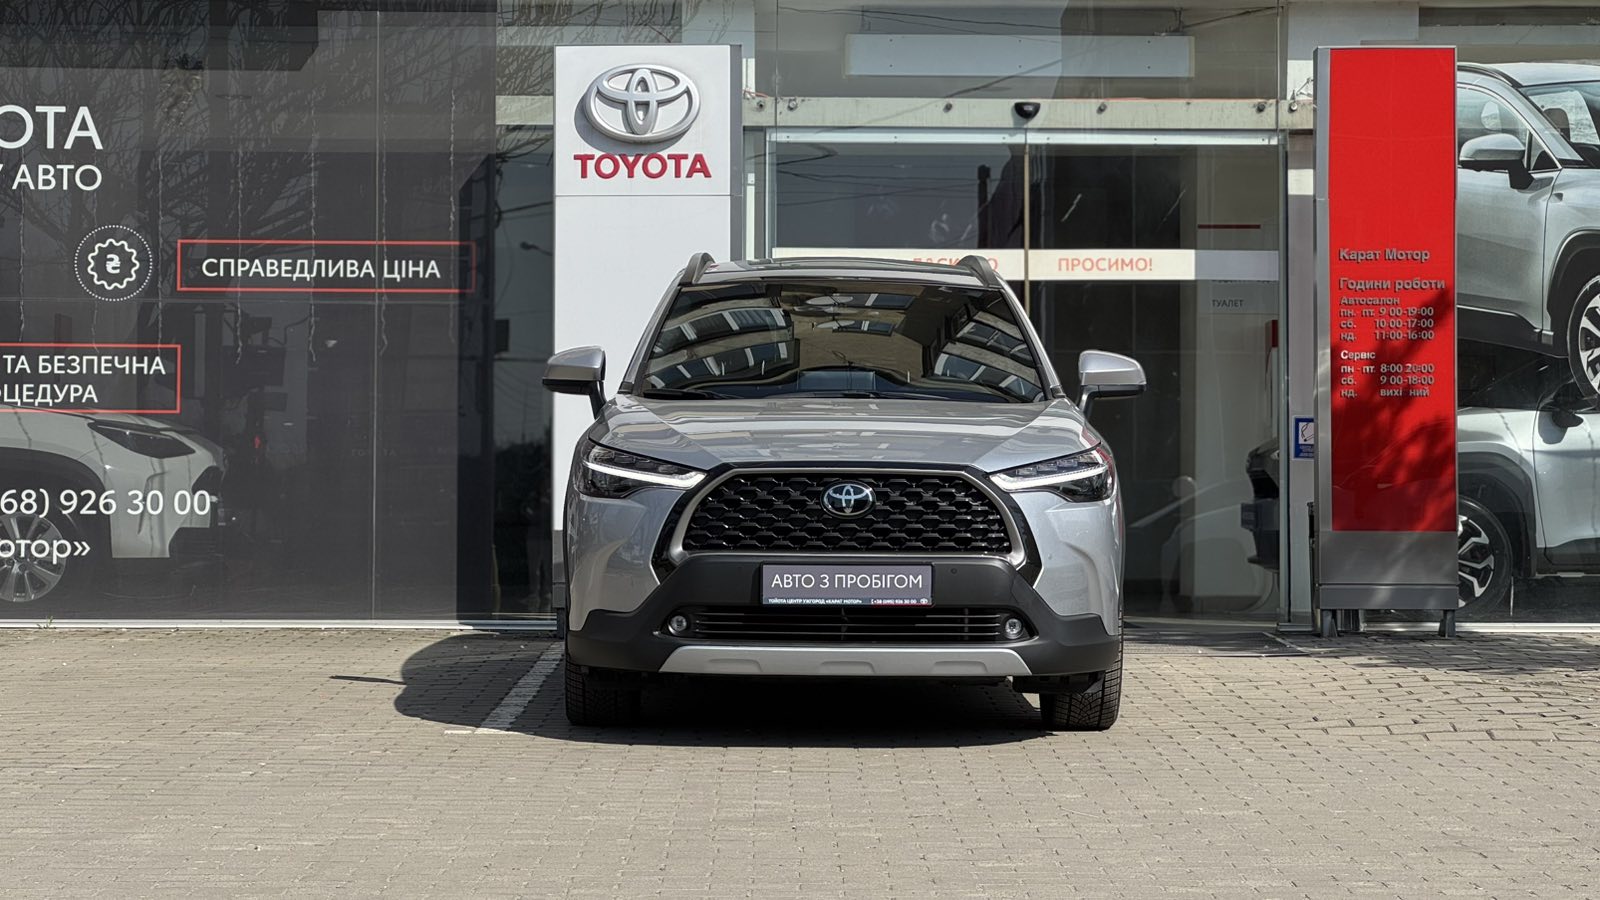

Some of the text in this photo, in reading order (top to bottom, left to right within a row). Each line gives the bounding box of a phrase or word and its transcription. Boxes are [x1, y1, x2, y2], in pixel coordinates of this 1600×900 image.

[573, 153, 712, 179] TOYOTA
[12, 163, 103, 191] АВТО
[1339, 248, 1431, 263] Карат Мотор
[202, 258, 441, 282] СПРАВЕДЛИВА ЦІНА
[1058, 257, 1153, 272] ПРОСИМО!
[1339, 276, 1446, 292] Години роботи
[1211, 299, 1245, 308] ТУАЛЕТ
[1340, 296, 1401, 305] Автосалон
[1340, 319, 1357, 328] сб.
[1340, 332, 1357, 342] нд.
[1340, 349, 1376, 361] Сервіс
[2, 355, 167, 375] ТА БЕЗПЕЧНА
[1341, 375, 1357, 385] сб.
[0, 384, 99, 407] ЦЕДУРА
[1341, 388, 1358, 398] нд.
[60, 490, 117, 515] 926
[127, 490, 164, 515] 30
[174, 490, 211, 515] 00
[771, 574, 923, 588] АВТО З ПРОБІГОМ
